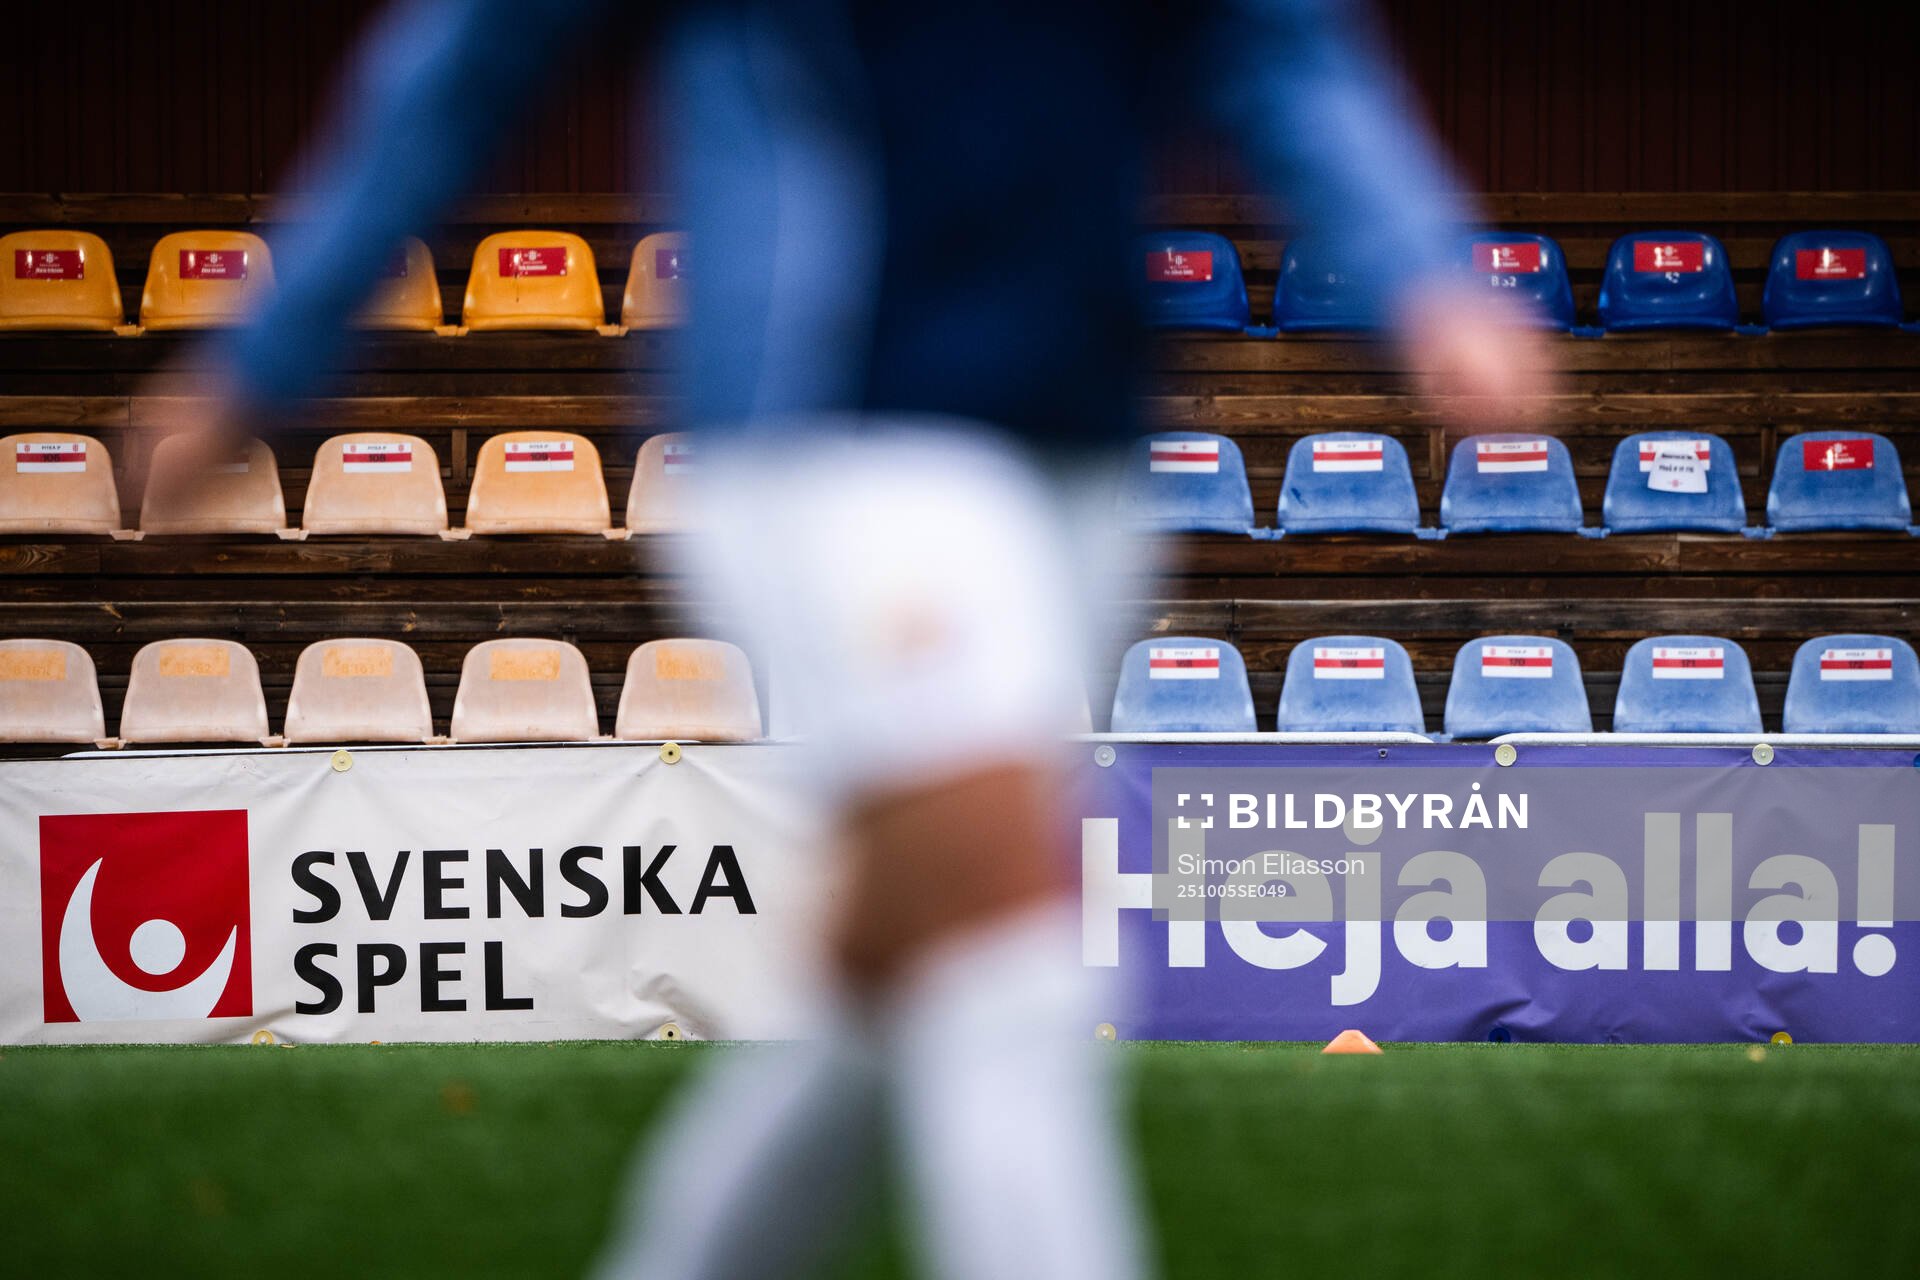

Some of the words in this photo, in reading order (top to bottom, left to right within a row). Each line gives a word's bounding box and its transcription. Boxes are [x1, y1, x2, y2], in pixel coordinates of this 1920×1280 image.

[291, 844, 757, 924] SVENSKA
[1081, 805, 1488, 1006] Heja
[1534, 812, 1897, 977] alla!
[293, 941, 535, 1016] SPEL
